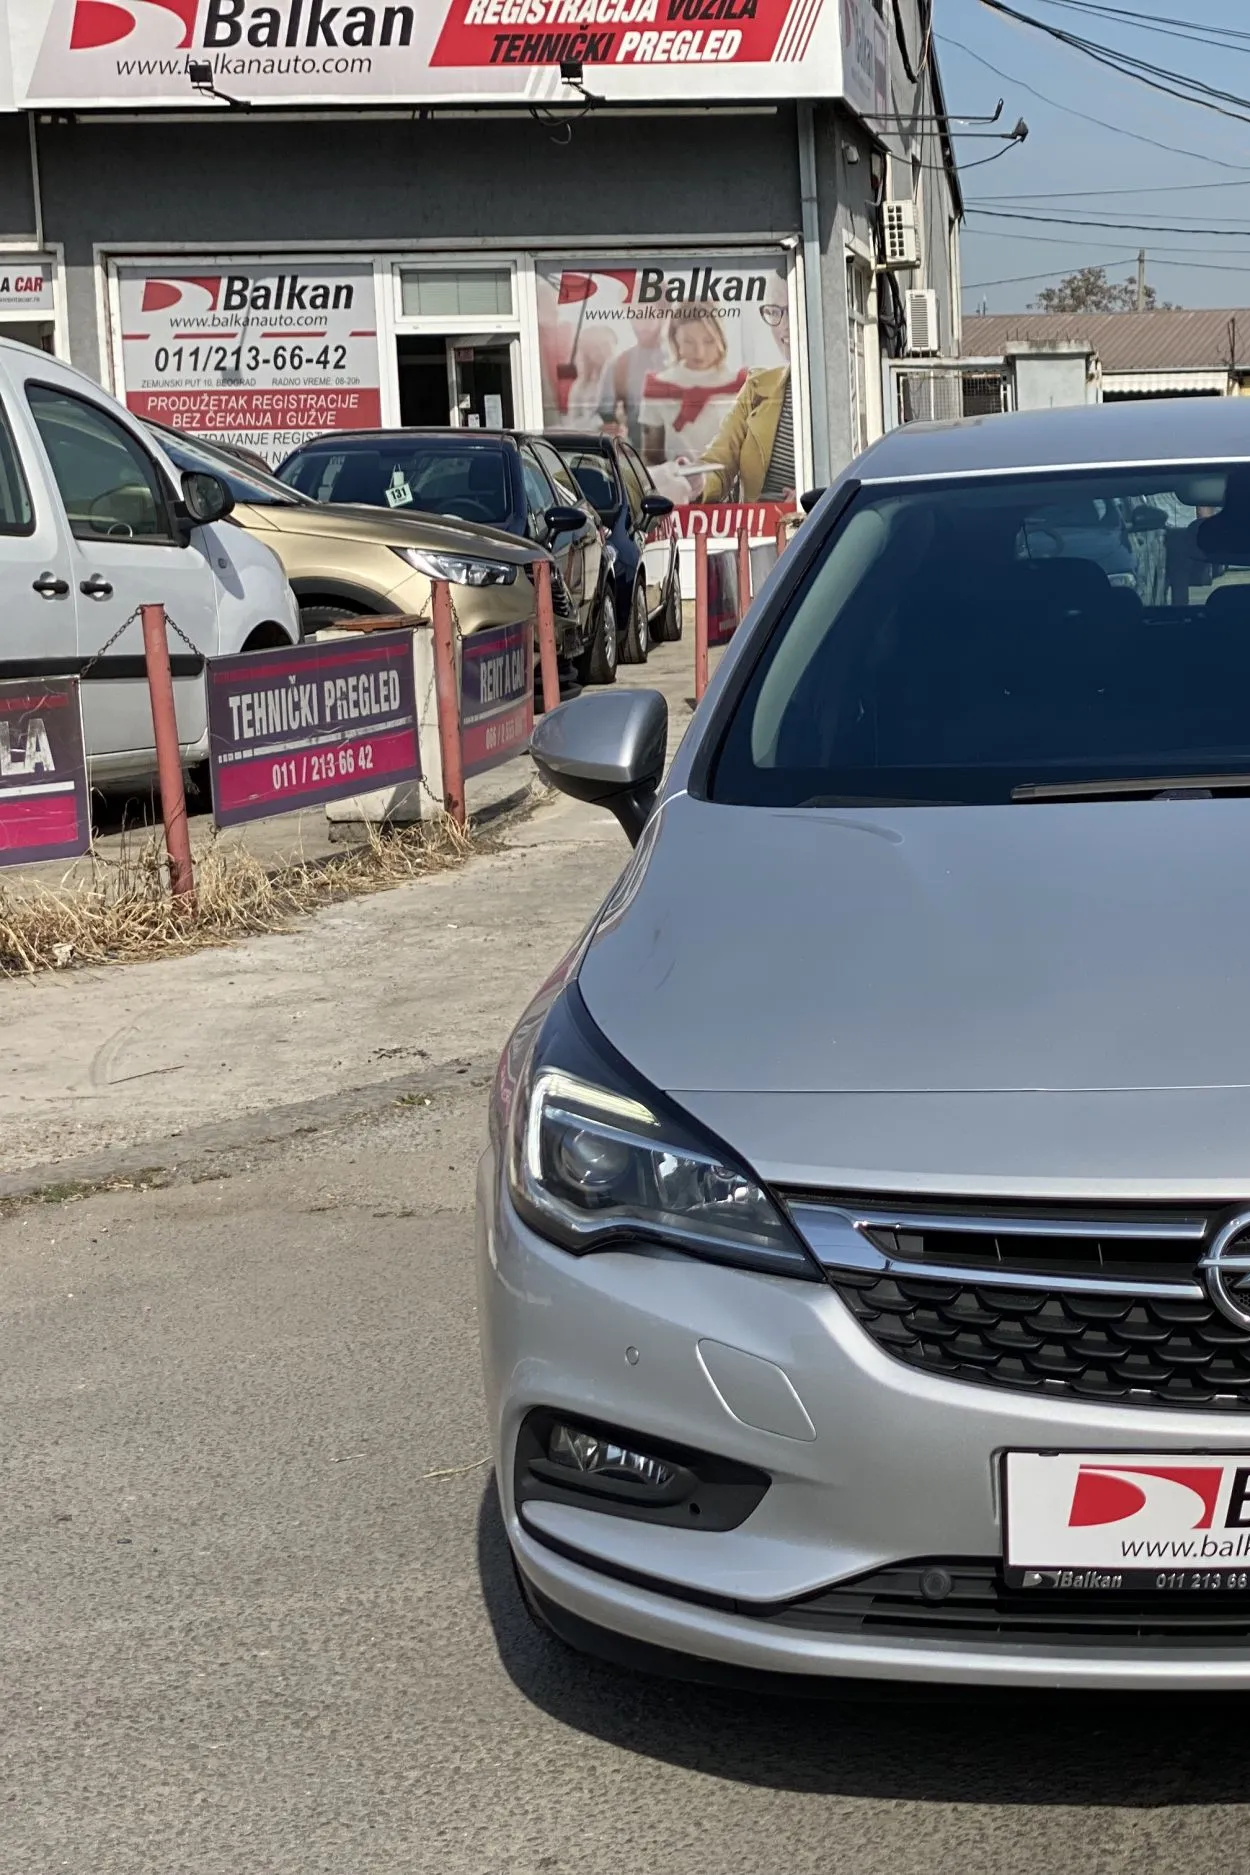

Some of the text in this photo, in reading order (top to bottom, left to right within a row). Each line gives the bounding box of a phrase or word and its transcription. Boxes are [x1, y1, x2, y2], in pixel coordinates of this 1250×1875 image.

[203, 0, 415, 48] Balkan
[463, 0, 757, 25] REGISTRACIJA VOZILA
[488, 25, 743, 63] TEHNIČKI PREGLED
[116, 53, 373, 76] www.blkanauto.com
[15, 276, 44, 292] CAR
[223, 275, 354, 311] Balkan
[638, 267, 767, 304] Balkan
[169, 313, 328, 329] www.balkanauto.com
[584, 306, 741, 320] www.balkanauto.com
[154, 344, 347, 372] 011/213-66-42
[184, 379, 201, 388] PUT
[216, 378, 257, 387] BEOGRAD
[272, 377, 301, 386] RADNO
[147, 393, 359, 411] PRODUŽETAK REGISTRACIJE
[172, 414, 201, 428] BEZ
[205, 411, 273, 427] ČEKANJA
[286, 410, 336, 426] GUŽVE
[391, 487, 407, 500] 131
[668, 508, 766, 539] ADU!!!
[480, 658, 504, 704] RENT
[228, 670, 400, 741] TEHNIČKI PREGLED
[272, 760, 297, 790] 011
[311, 752, 336, 781] 213
[338, 748, 355, 775] 66
[358, 744, 374, 771] 42
[1155, 1574, 1185, 1588] 011
[1191, 1573, 1221, 1589] 213
[1226, 1573, 1248, 1588] 66
